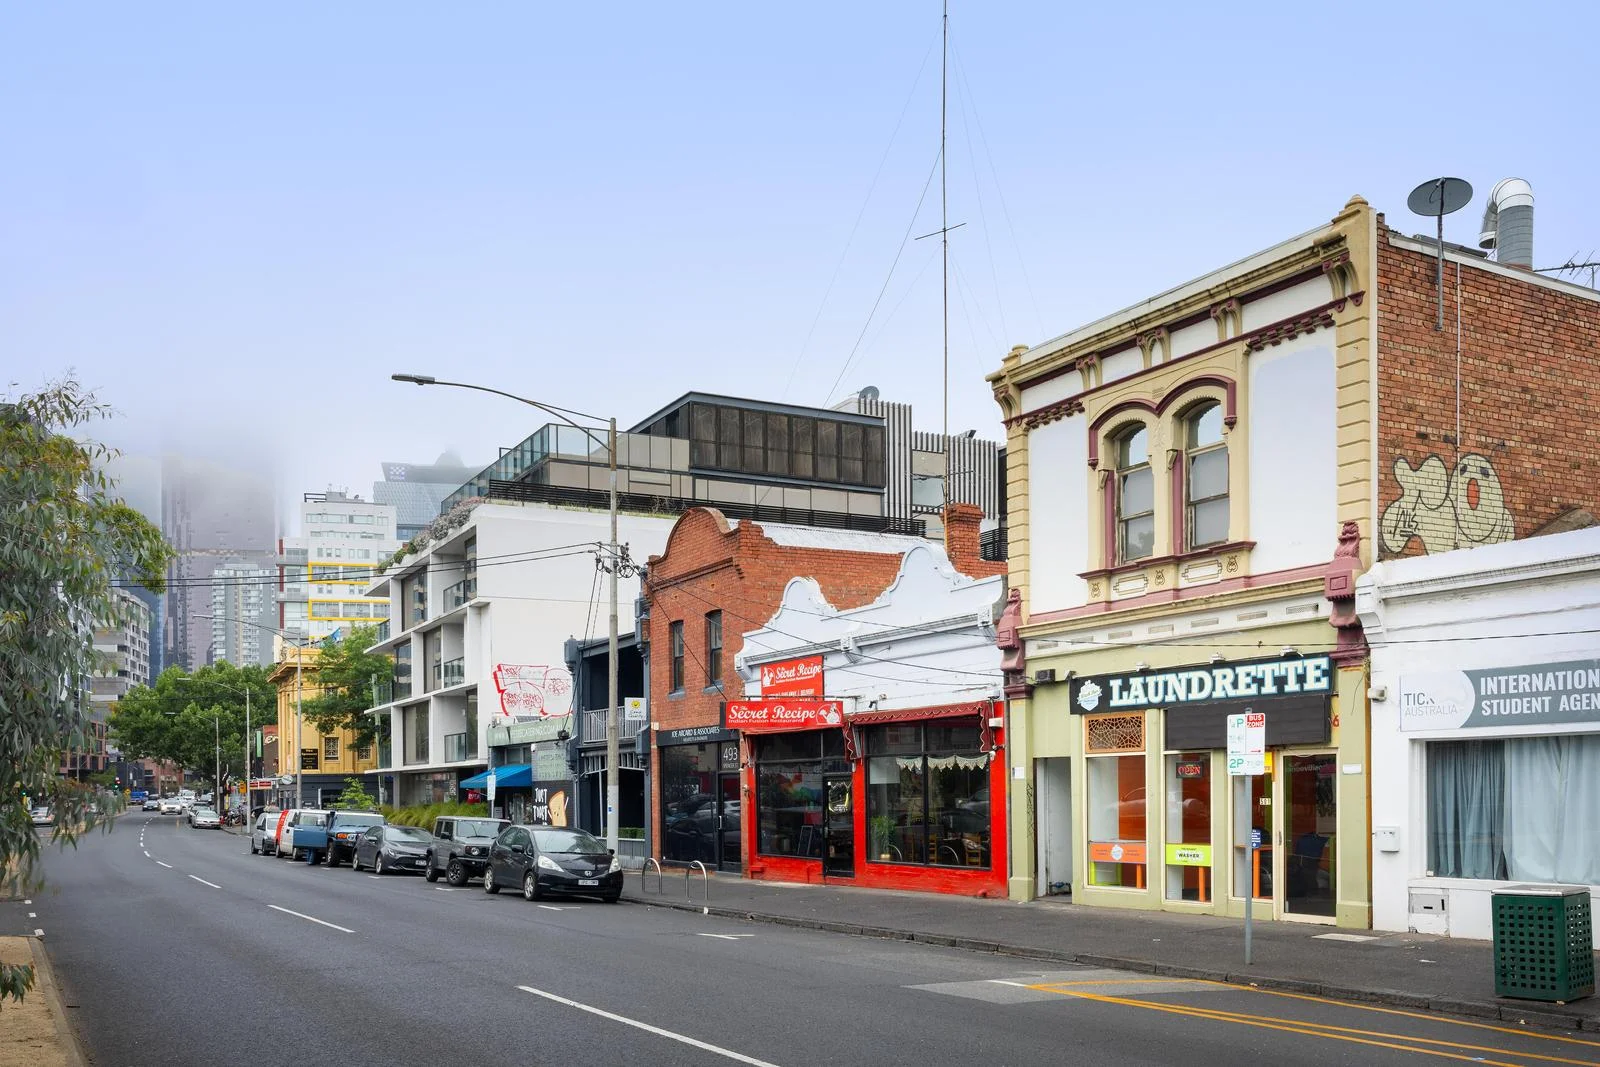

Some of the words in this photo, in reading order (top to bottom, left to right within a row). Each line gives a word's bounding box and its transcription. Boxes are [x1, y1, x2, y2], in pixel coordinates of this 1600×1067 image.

[775, 667, 795, 680] Secret
[797, 663, 822, 677] Recipe
[1109, 657, 1329, 707] LAUNDRETTE
[729, 705, 768, 719] Secret
[772, 705, 816, 722] Recipe
[1405, 704, 1458, 717] AUSTRALIA
[1481, 696, 1551, 716] STUDENT
[723, 747, 738, 761] 493
[1230, 758, 1244, 768] 2P
